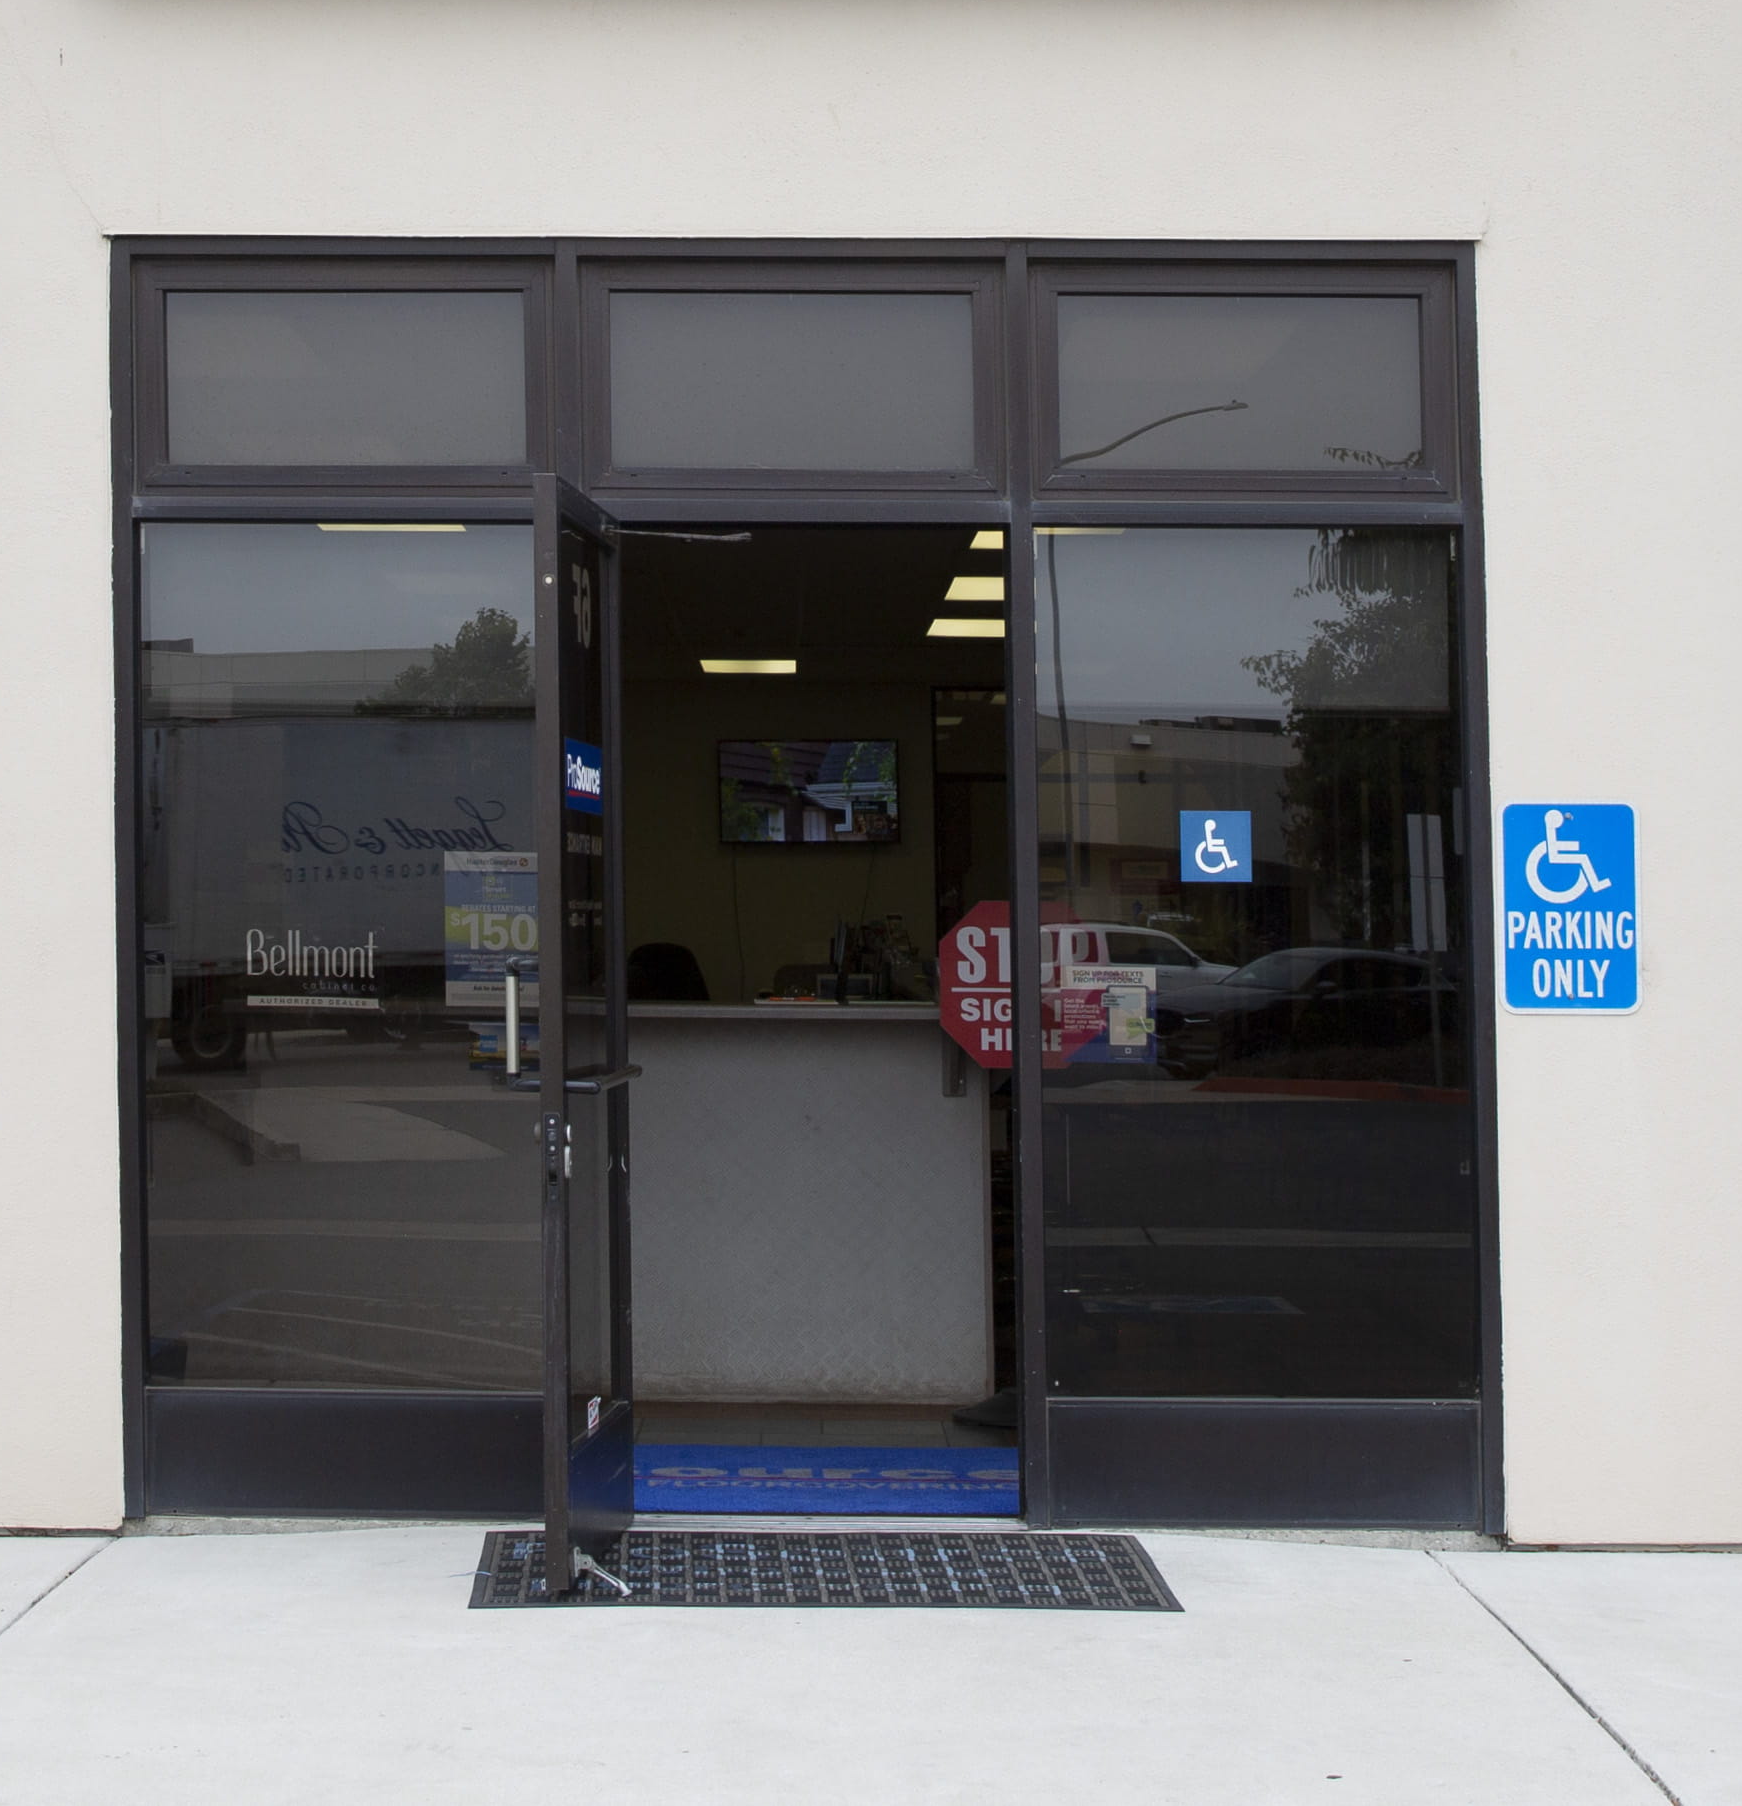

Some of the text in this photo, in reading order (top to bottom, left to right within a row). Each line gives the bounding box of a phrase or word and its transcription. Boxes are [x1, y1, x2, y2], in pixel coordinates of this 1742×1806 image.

[566, 753, 601, 795] ProSource
[449, 913, 537, 951] $150
[1508, 910, 1634, 950] PARKING
[246, 928, 379, 979] Bellmont
[1532, 958, 1611, 998] ONLY
[258, 997, 324, 1006] AUTHORIZED
[980, 1027, 1062, 1052] HE
[634, 1466, 1018, 1482] ource
